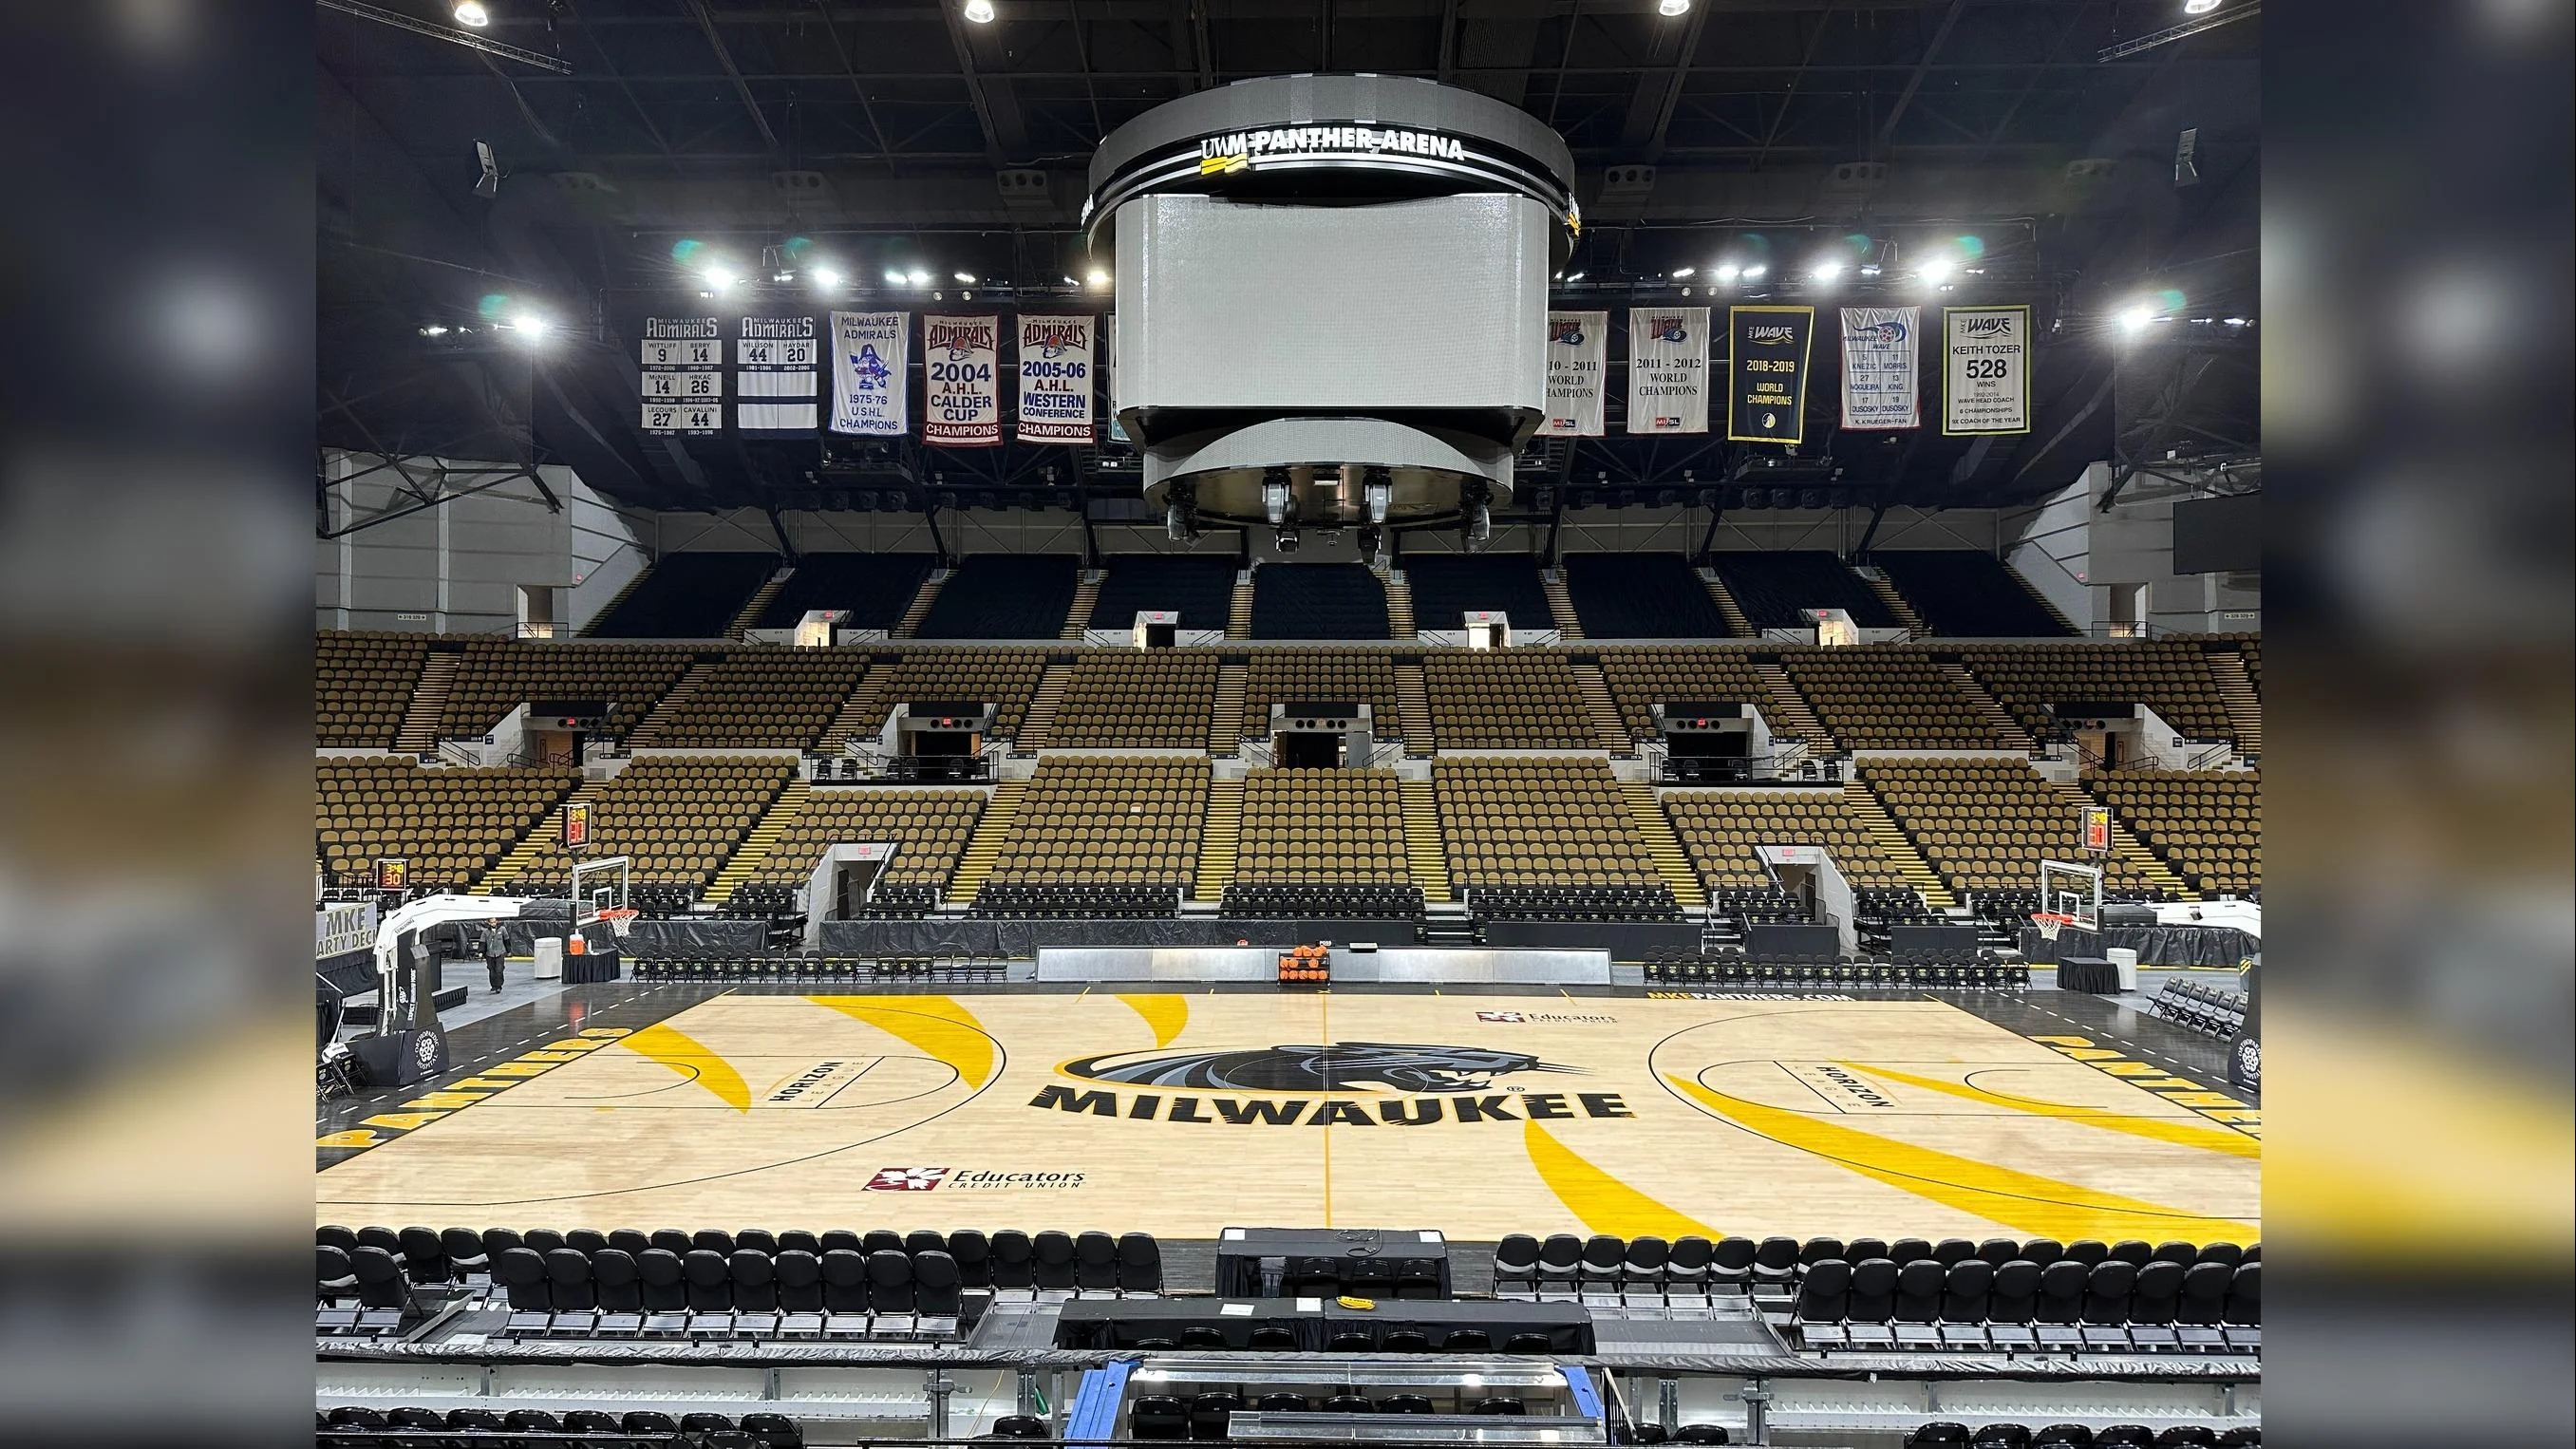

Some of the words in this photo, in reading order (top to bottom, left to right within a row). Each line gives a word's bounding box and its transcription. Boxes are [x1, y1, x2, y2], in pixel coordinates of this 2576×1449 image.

[1201, 132, 1248, 160] UWM
[1255, 127, 1372, 152] PANTHER
[1381, 130, 1464, 160] ARENA
[647, 317, 718, 337] ADMIRALS
[742, 316, 814, 337] ADMIRALS
[842, 317, 899, 327] MILWAUKEE
[1968, 318, 2011, 333] WAVE
[844, 329, 896, 339] ADMIRALS
[928, 324, 993, 349] ADMIRALS
[1024, 323, 1087, 350] ADMIRALS
[1754, 326, 1794, 339] WAVE
[658, 348, 667, 362] 9
[693, 348, 708, 362] 14
[749, 348, 767, 361] 44
[787, 348, 806, 362] 20
[1953, 346, 1983, 355] KEITH
[1985, 345, 2021, 354] TOZER
[1022, 360, 1086, 378] 2005-06
[1549, 360, 1561, 370] 10
[1572, 361, 1597, 371] 2011
[1636, 358, 1661, 368] 2011
[1674, 358, 1701, 368] 2012
[1747, 360, 1795, 372] 2018-2019
[1966, 358, 2007, 378] 528
[931, 362, 991, 382] 2004
[1650, 373, 1687, 382] WORLD
[1034, 379, 1074, 392] A.H.L.
[1548, 375, 1584, 385] WORLD
[656, 381, 670, 394] 14
[691, 380, 709, 394] 26
[942, 382, 982, 395] A.H.L.
[1547, 388, 1594, 397] HAMPIONS
[1639, 386, 1697, 396] CHAMPIONS
[1757, 382, 1784, 393] WORLD
[850, 394, 888, 405] 1975-76
[931, 395, 992, 408] CALDER
[1025, 391, 1086, 408] WESTERN
[1747, 395, 1792, 405] CHAMPIONS
[943, 409, 978, 421] CUP
[1023, 407, 1085, 418] CONFERENCE
[653, 413, 671, 426] 27
[691, 413, 709, 426] 44
[840, 419, 898, 430] CHAMPIONS
[926, 424, 998, 436] CHAMPIONS
[1018, 423, 1091, 436] CHAMPIONS
[385, 874, 401, 884] 30
[326, 907, 366, 937] MKE
[317, 935, 347, 956] ARTY
[1647, 991, 1856, 1002] MKEPANTHERS.COM
[316, 1028, 633, 1148] PANTHERS
[768, 1062, 844, 1101] HORIZON
[1815, 1066, 1895, 1107] HORIZON
[1027, 1084, 1637, 1126] MILWAUKEE
[953, 1170, 1086, 1182] Educators
